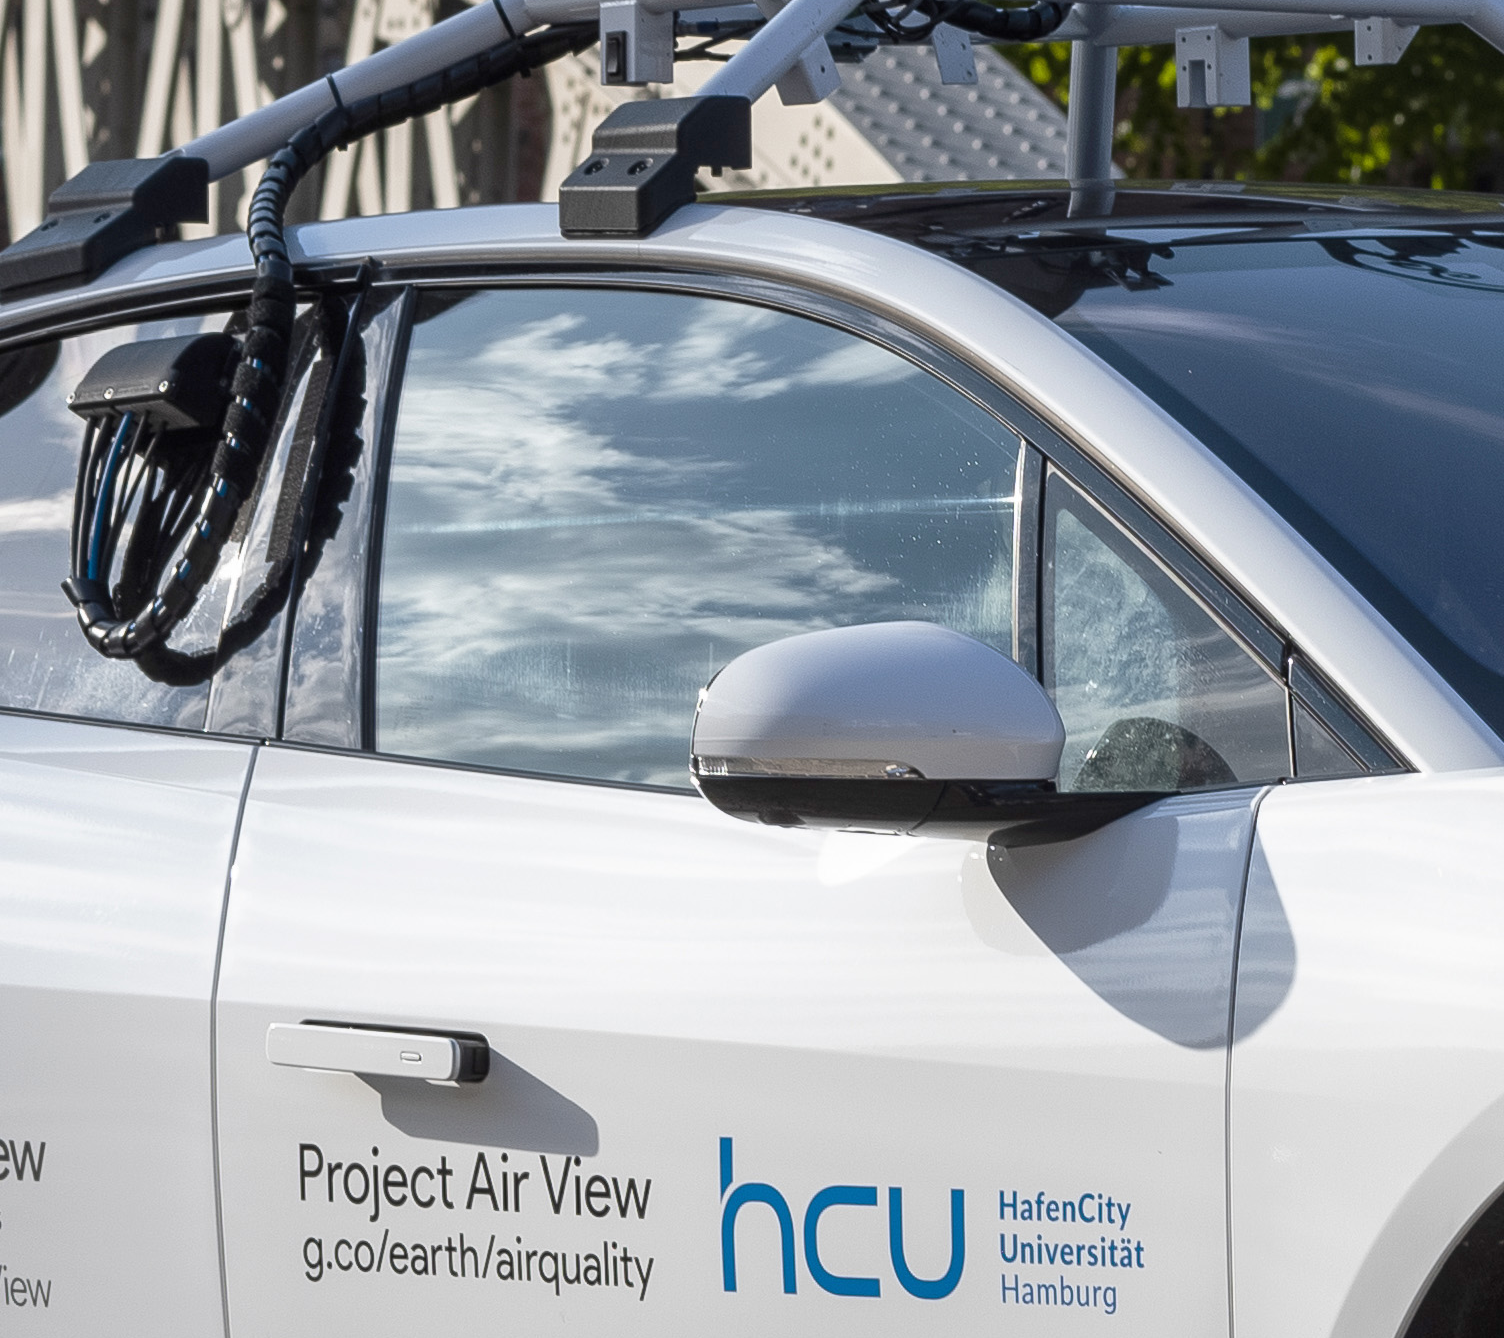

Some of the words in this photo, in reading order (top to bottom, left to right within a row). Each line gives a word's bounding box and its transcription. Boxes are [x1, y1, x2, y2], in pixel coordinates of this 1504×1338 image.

[298, 1142, 455, 1223] Project
[465, 1151, 530, 1213] Air
[539, 1154, 653, 1220] View
[999, 1190, 1132, 1231] HafenCity
[718, 1136, 966, 1300] hcu
[303, 1228, 655, 1302] g.co/earth/airquality
[999, 1233, 1146, 1269] Universität
[1001, 1273, 1118, 1315] Hamburg
